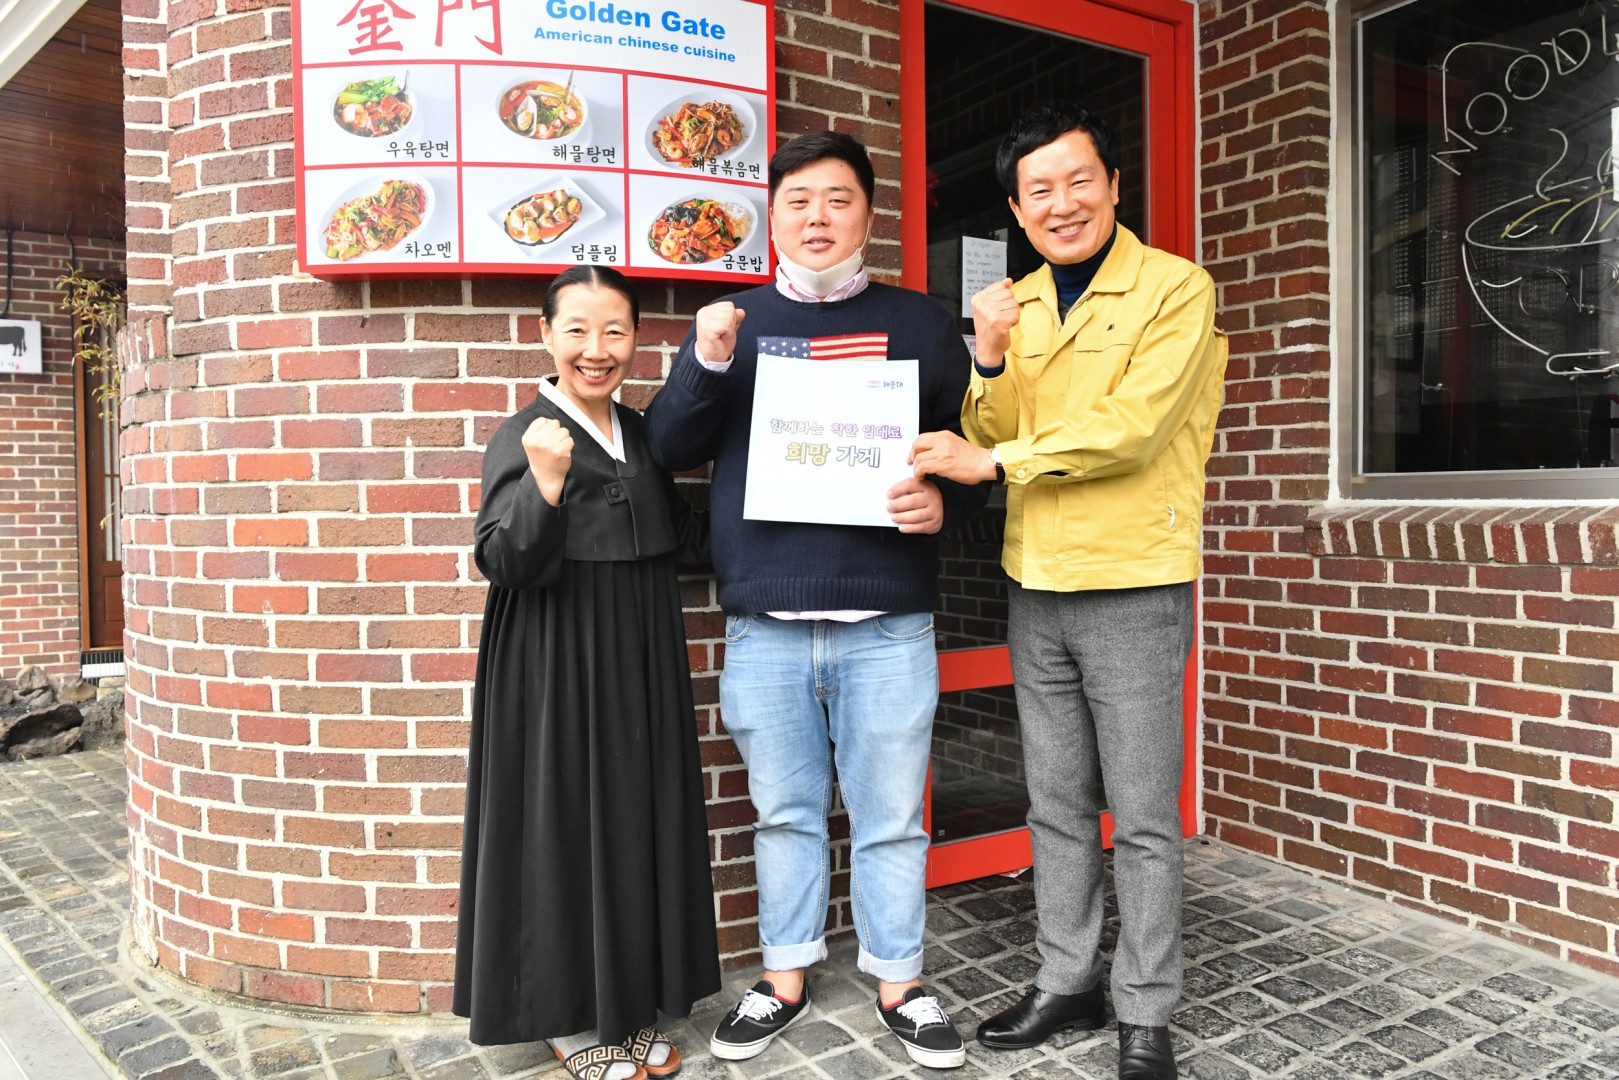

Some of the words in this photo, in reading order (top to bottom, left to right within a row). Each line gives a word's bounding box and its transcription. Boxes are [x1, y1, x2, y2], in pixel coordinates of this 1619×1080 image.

[545, 0, 652, 31] Golden
[661, 10, 727, 41] Gate
[534, 26, 614, 47] American
[618, 35, 680, 54] chinese
[683, 45, 737, 63] cuisine
[387, 140, 449, 159] 우육탕면
[552, 143, 615, 164] 해물탕면
[692, 155, 760, 180] 해물볶음면
[405, 241, 451, 259] 차오멘
[571, 244, 617, 262] 덤플링
[722, 254, 764, 273] 금문밥
[770, 418, 824, 436] 함께하는
[831, 423, 859, 439] 착한
[862, 424, 902, 440] 임대료
[785, 442, 830, 466] 희망
[836, 445, 881, 469] 가게
